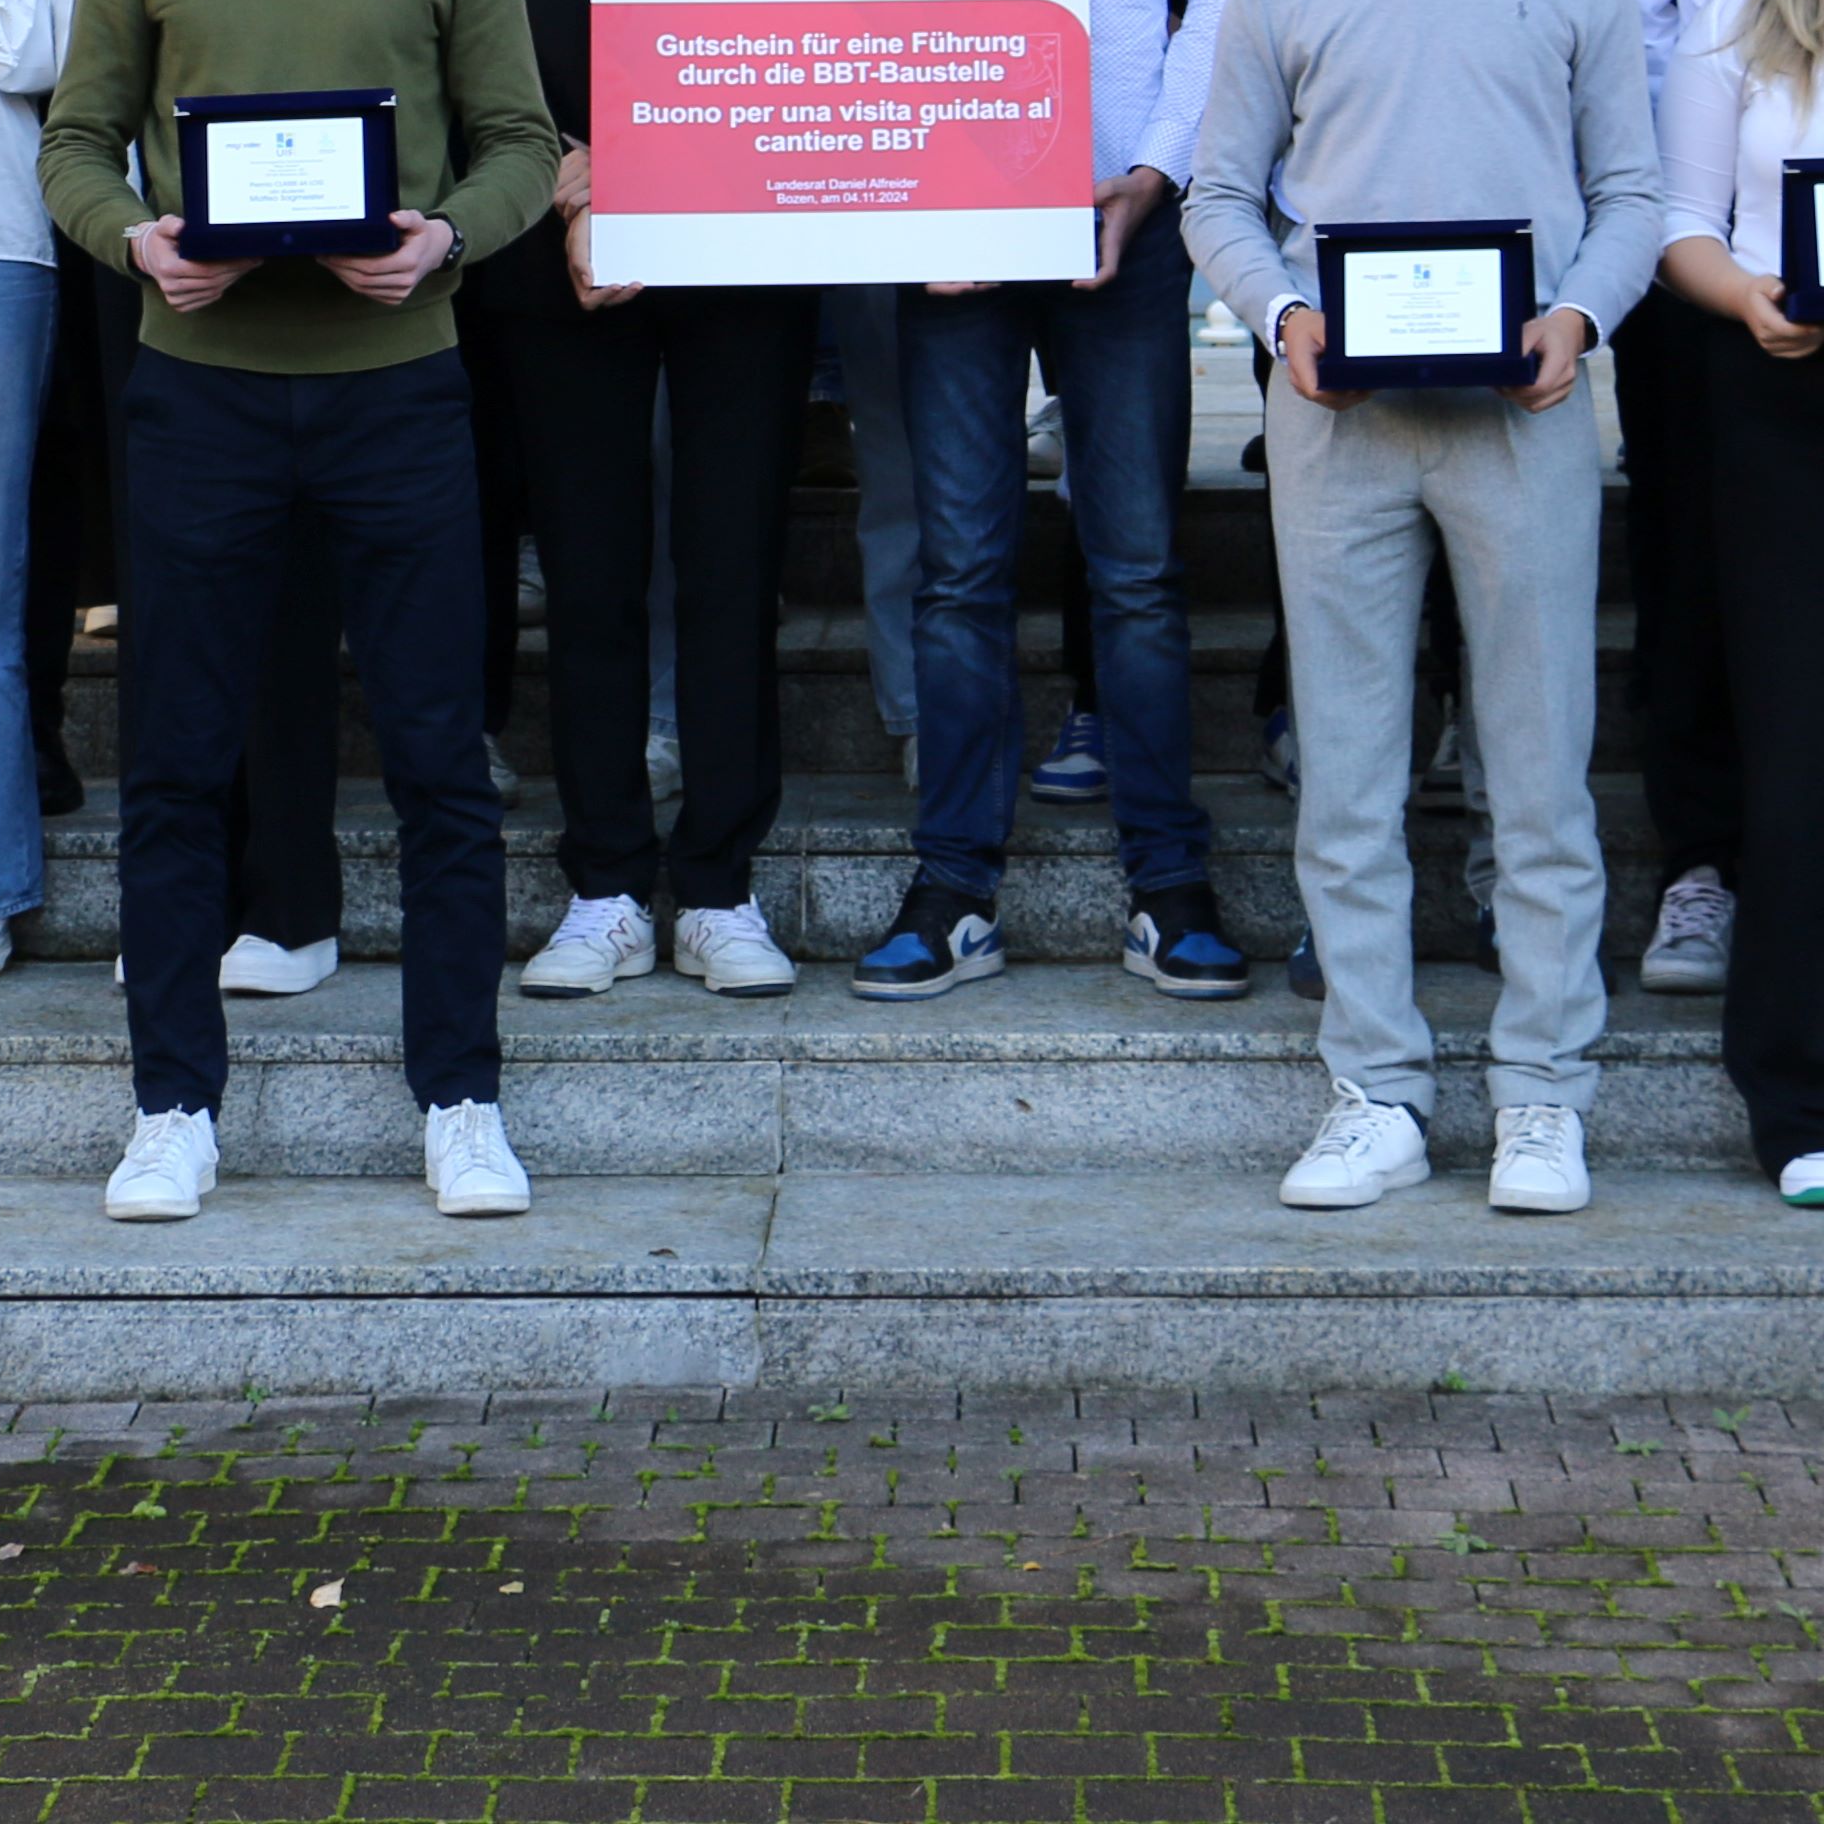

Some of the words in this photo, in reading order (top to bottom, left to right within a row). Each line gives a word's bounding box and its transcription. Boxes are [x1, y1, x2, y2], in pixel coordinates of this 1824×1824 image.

[657, 34, 793, 56] Gutschein
[801, 33, 840, 54] für
[847, 33, 903, 54] eine
[912, 32, 1025, 57] Führung
[679, 63, 756, 85] durch
[765, 63, 805, 84] die
[814, 60, 1004, 83] BBT-Baustelle
[633, 102, 721, 123] Buono
[730, 106, 773, 128] per
[782, 106, 831, 122] una
[839, 100, 911, 121] visita
[920, 98, 1020, 126] guidata
[1028, 97, 1050, 118] al
[755, 130, 863, 152] cantiere
[872, 128, 929, 150] BBT
[766, 179, 827, 191] Landesrat
[828, 178, 868, 190] Daniel
[868, 177, 919, 189] Alfreider
[776, 192, 819, 205] Bozen,
[820, 194, 841, 204] am
[842, 191, 909, 204] 04.11.2024
